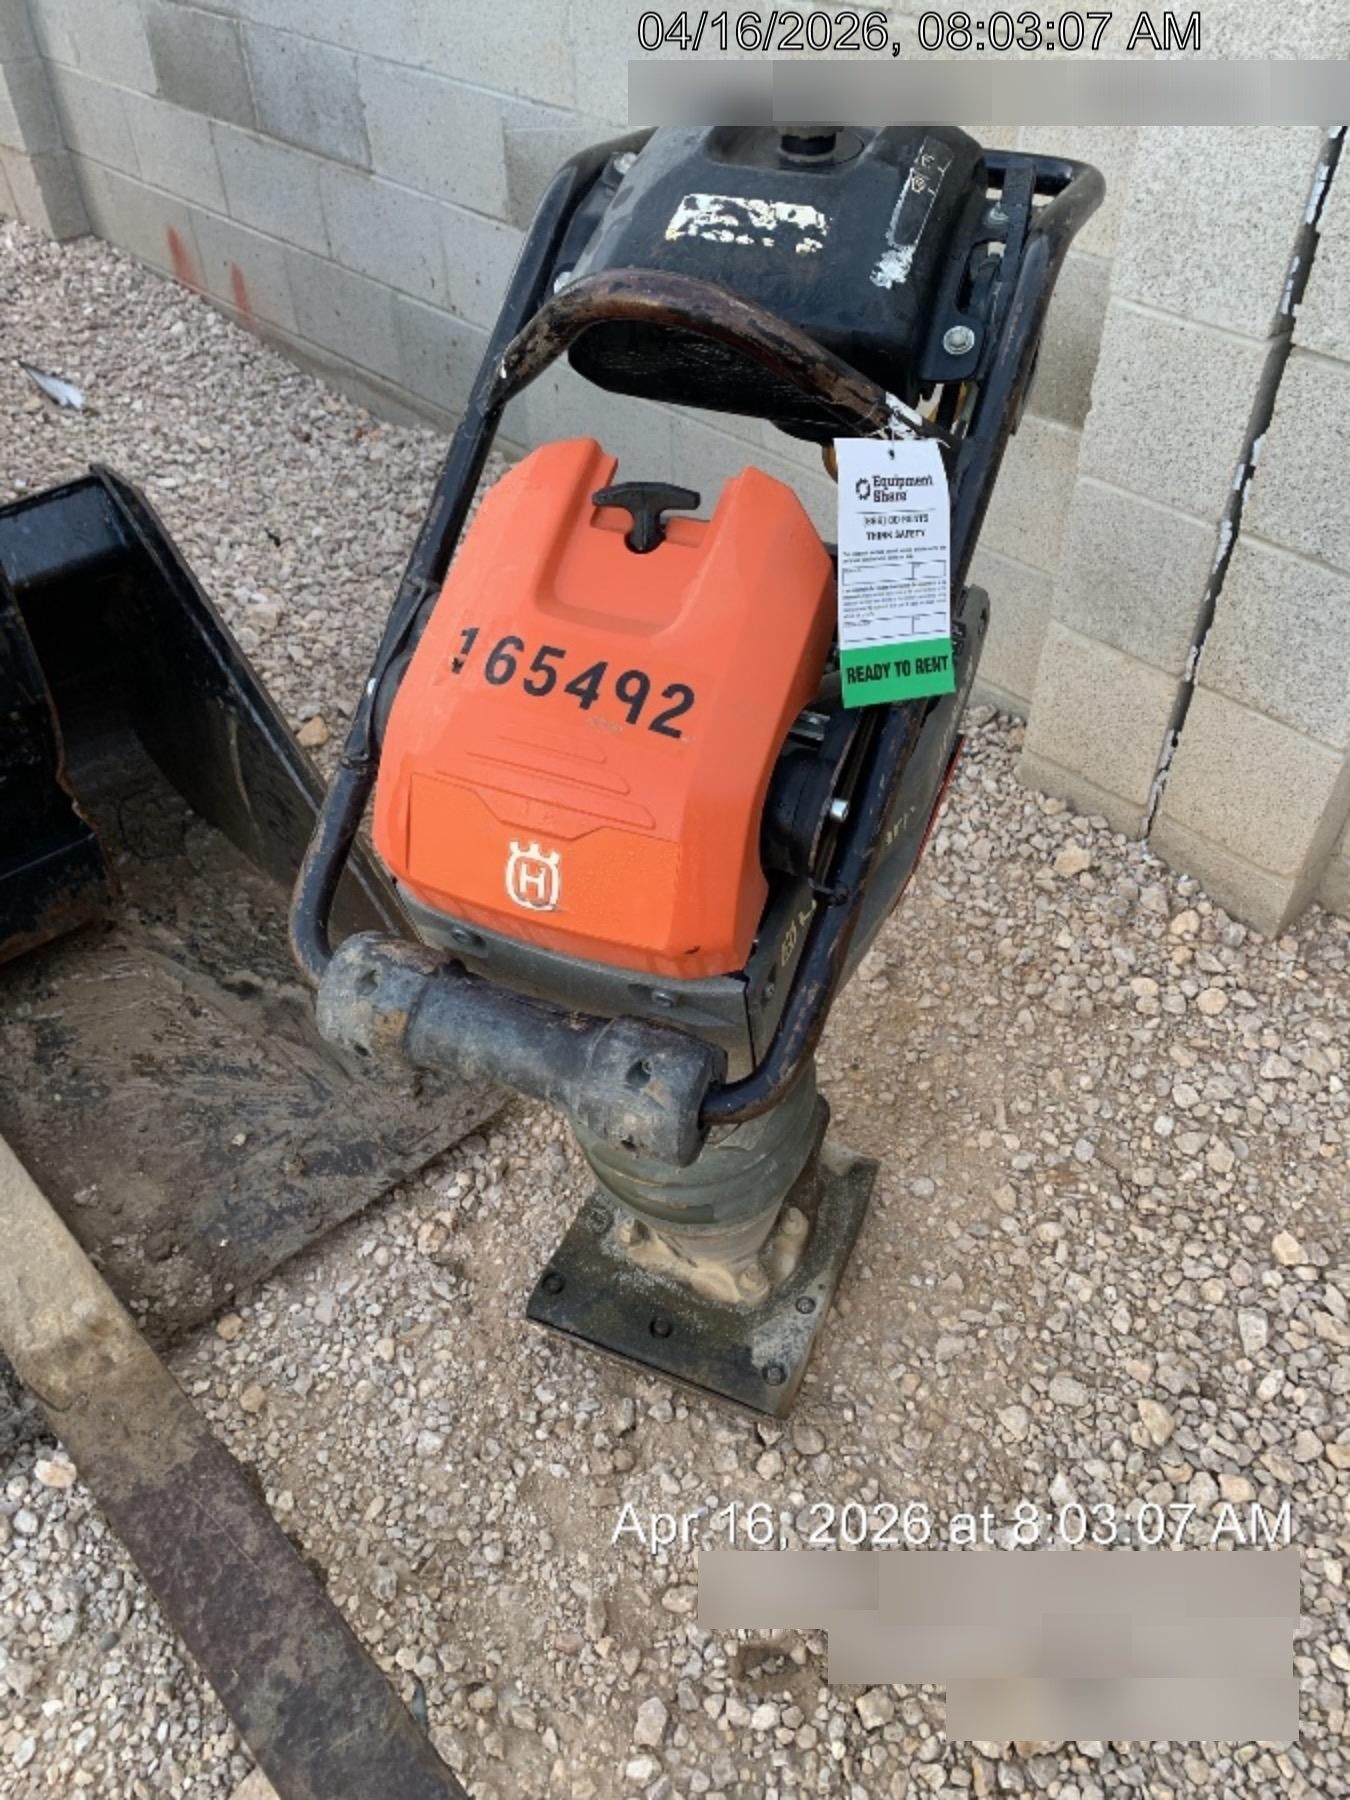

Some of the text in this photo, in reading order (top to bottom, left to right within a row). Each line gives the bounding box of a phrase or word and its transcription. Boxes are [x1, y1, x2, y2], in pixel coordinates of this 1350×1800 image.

[872, 474, 933, 491] Equipment
[873, 490, 907, 502] Share
[846, 655, 948, 684] READY TO RENT
[450, 626, 696, 740] 165492
